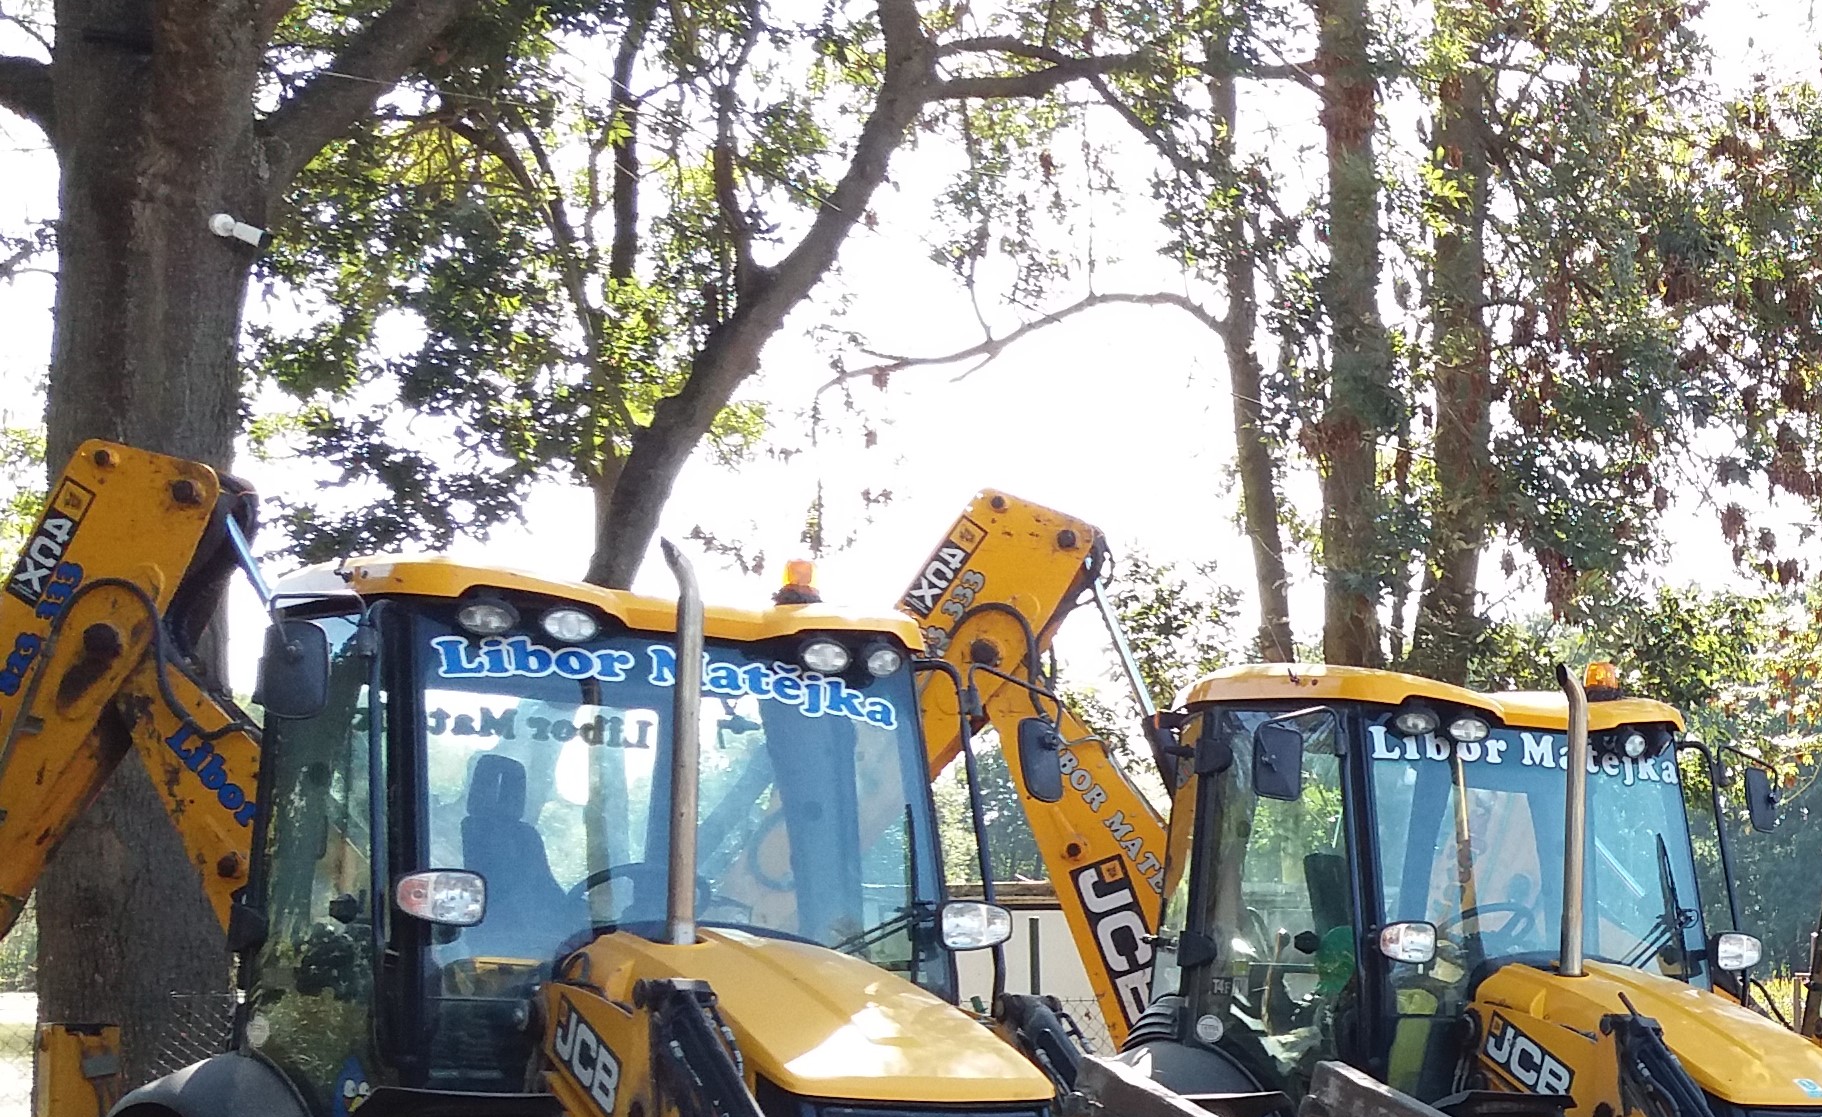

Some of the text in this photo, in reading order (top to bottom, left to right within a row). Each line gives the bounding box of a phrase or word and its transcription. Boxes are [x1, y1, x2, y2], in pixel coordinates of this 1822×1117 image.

[15, 517, 73, 593] 4CX
[910, 547, 966, 608] 4CX
[430, 636, 635, 682] Libor
[1368, 725, 1508, 764] Libor
[1059, 748, 1107, 813] BOR
[555, 1011, 619, 1114] JCB
[1486, 1025, 1570, 1096] JCB
